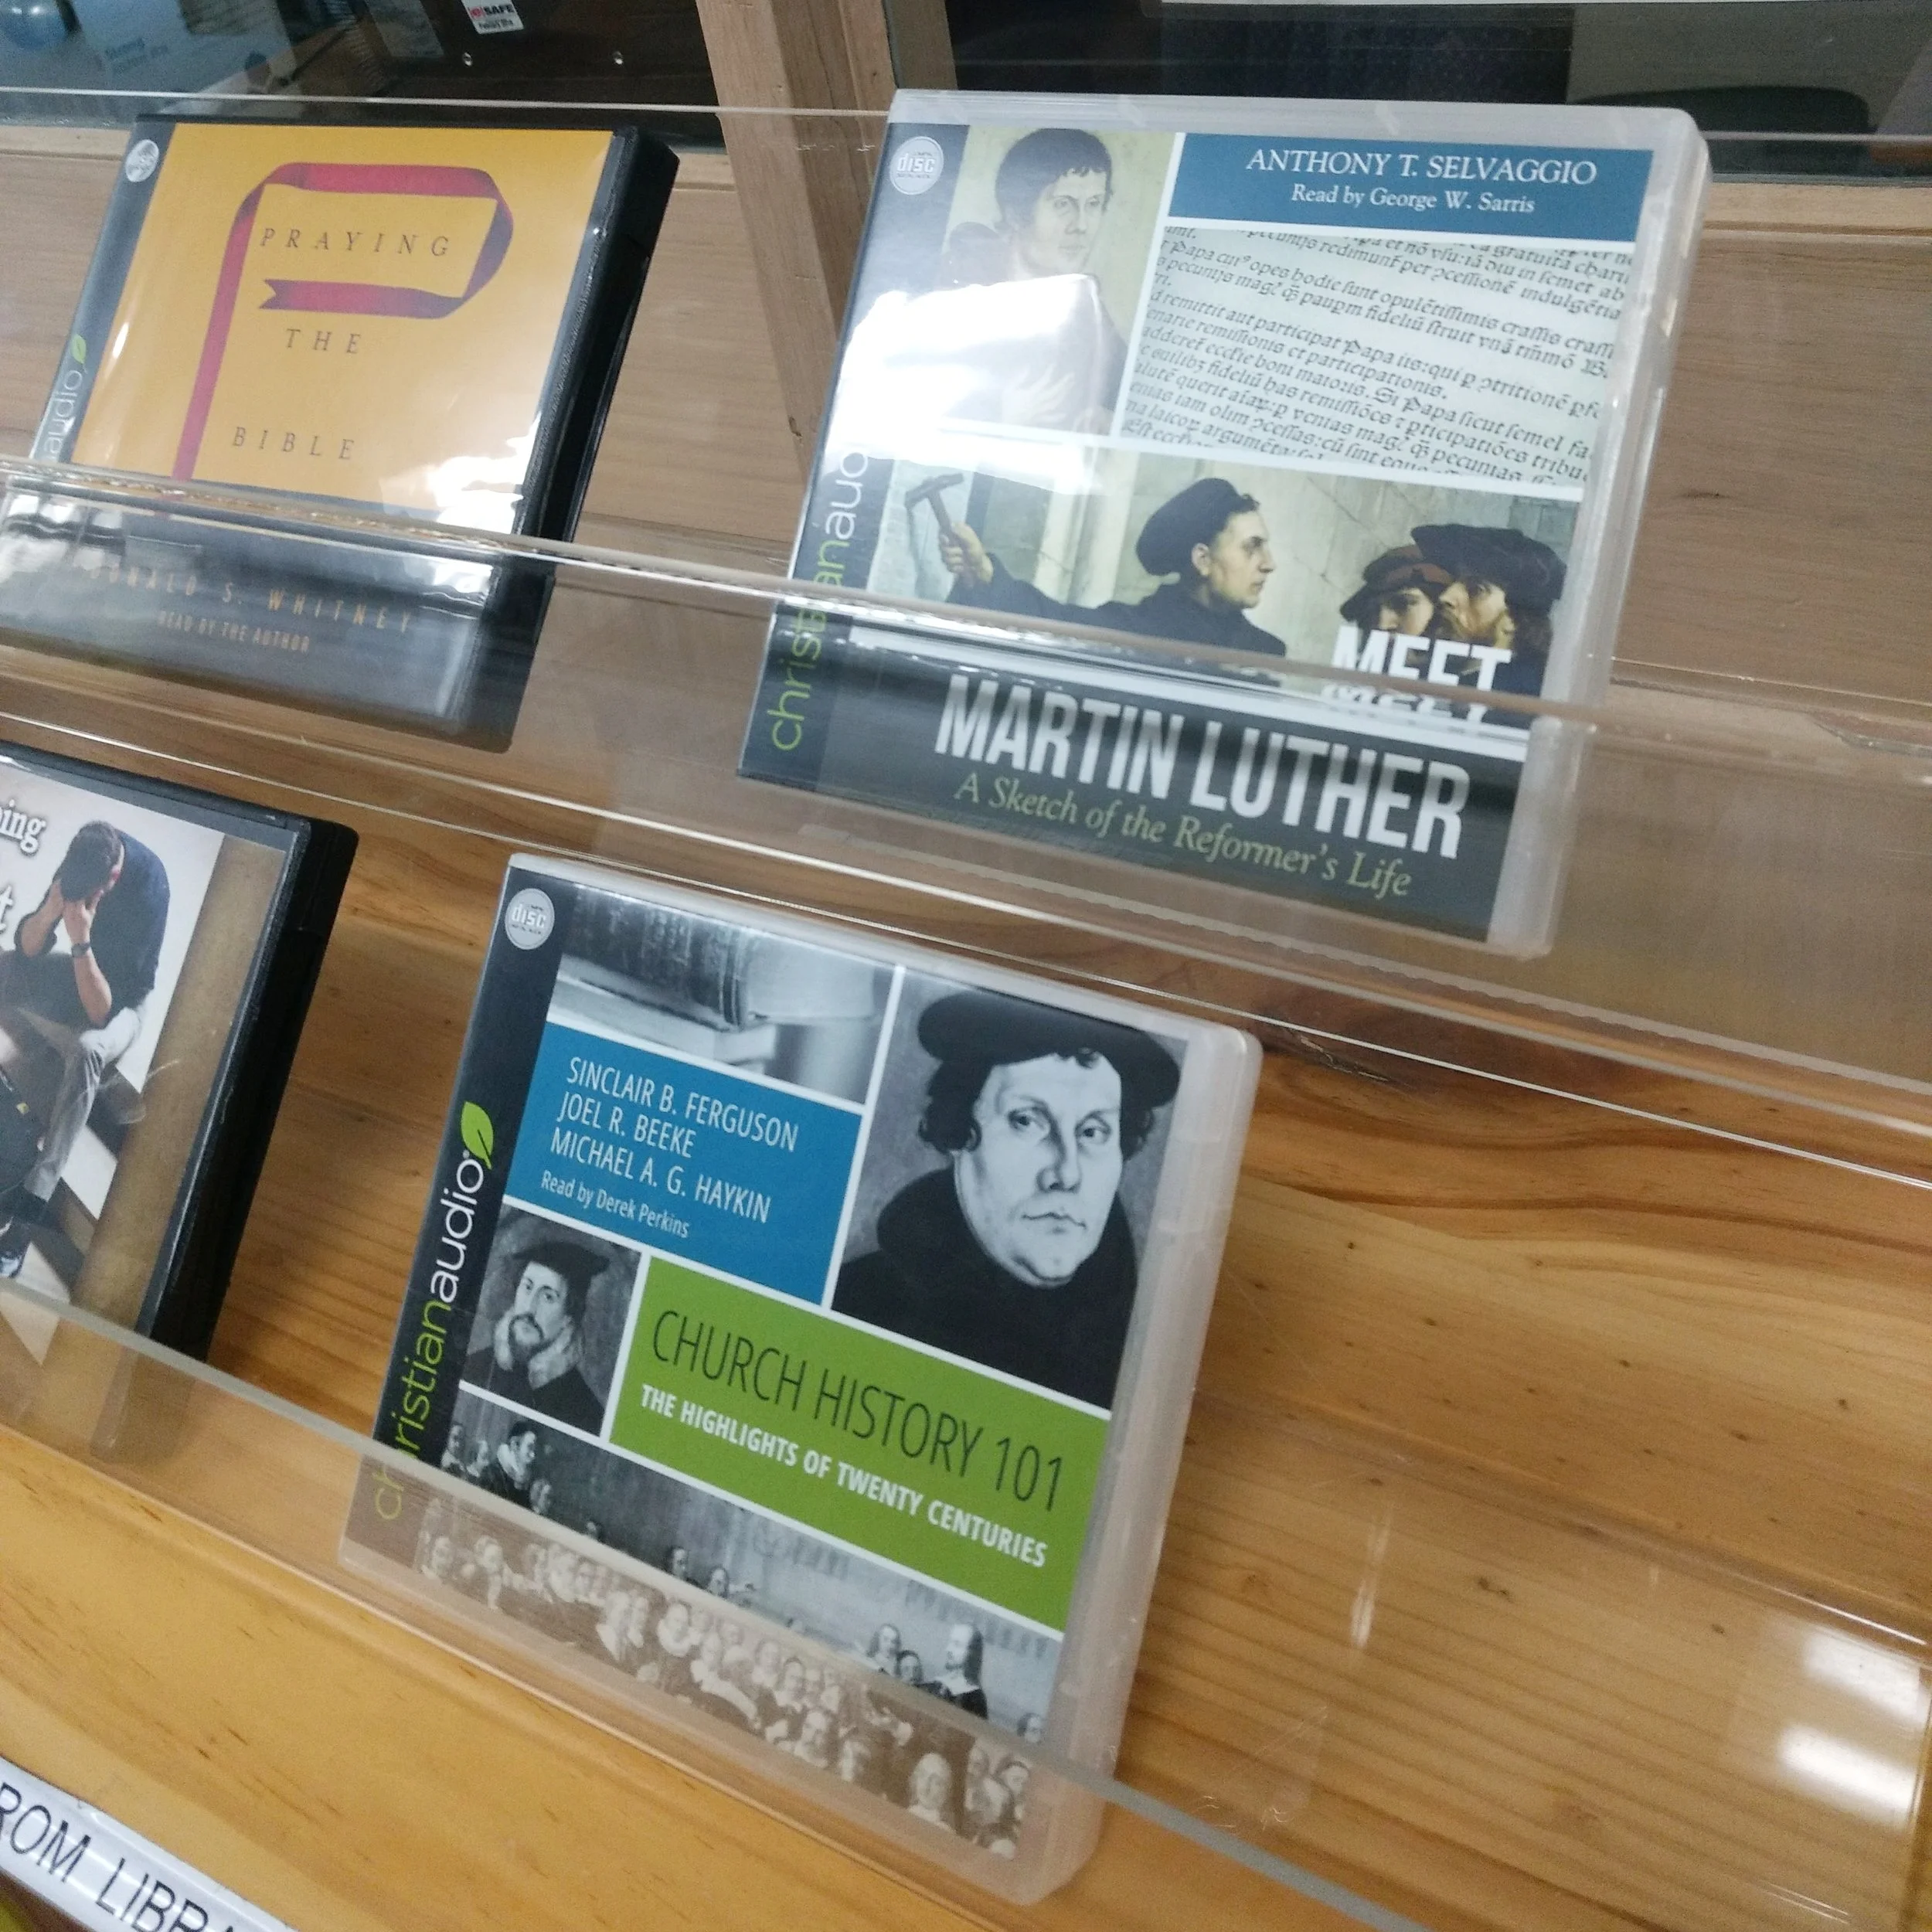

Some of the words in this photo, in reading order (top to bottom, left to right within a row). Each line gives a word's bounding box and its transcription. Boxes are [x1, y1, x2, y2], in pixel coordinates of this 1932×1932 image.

[1246, 148, 1392, 176] ANTHONY
[1398, 154, 1419, 177] T.
[1426, 155, 1597, 185] SELVAGGIO
[1291, 183, 1339, 203] Read
[1343, 185, 1366, 209] by
[1369, 187, 1437, 212] George
[1444, 190, 1472, 209] W.
[1478, 192, 1536, 213] Sarris
[259, 227, 451, 257] PRAYING
[285, 328, 362, 354] THE
[232, 426, 355, 461] BIBLE
[221, 581, 243, 605] S.
[267, 587, 412, 634] WHITNEY
[221, 621, 248, 642] THE
[1323, 625, 1512, 713] MEET
[934, 674, 1185, 800] MARTIN
[1190, 720, 1471, 860] LUTHER
[0, 799, 46, 855] ing
[954, 772, 980, 804] A
[988, 775, 1078, 825] Sketch
[1084, 799, 1123, 838] of
[1122, 804, 1167, 843] the
[1173, 814, 1339, 881] Reformer's
[1346, 850, 1413, 900] Life
[556, 1090, 602, 1130] JOEL
[608, 1106, 626, 1137] R.
[633, 1114, 697, 1159] BEEKE
[566, 1056, 656, 1107] SINCLAIR
[658, 1084, 677, 1115] B.
[684, 1091, 800, 1153] FERGUSON
[541, 1169, 576, 1199] Read
[577, 1181, 595, 1209] by
[596, 1189, 636, 1220] Derek
[638, 1202, 691, 1238] Perkins
[549, 1127, 634, 1181] MICHAEL
[639, 1156, 658, 1188] A.
[666, 1165, 687, 1197] G.
[694, 1173, 772, 1225] HAYKIN
[652, 1309, 807, 1412] CHURCH
[814, 1368, 984, 1478] HISTORY
[996, 1436, 1063, 1512] 101
[641, 1383, 678, 1419] THE
[680, 1400, 800, 1468] HIGHLIGHTS
[803, 1449, 832, 1478] OF
[836, 1461, 924, 1517] TWENTY
[927, 1499, 1048, 1569] CENTURIES
[96, 1857, 235, 1932] LIBR
